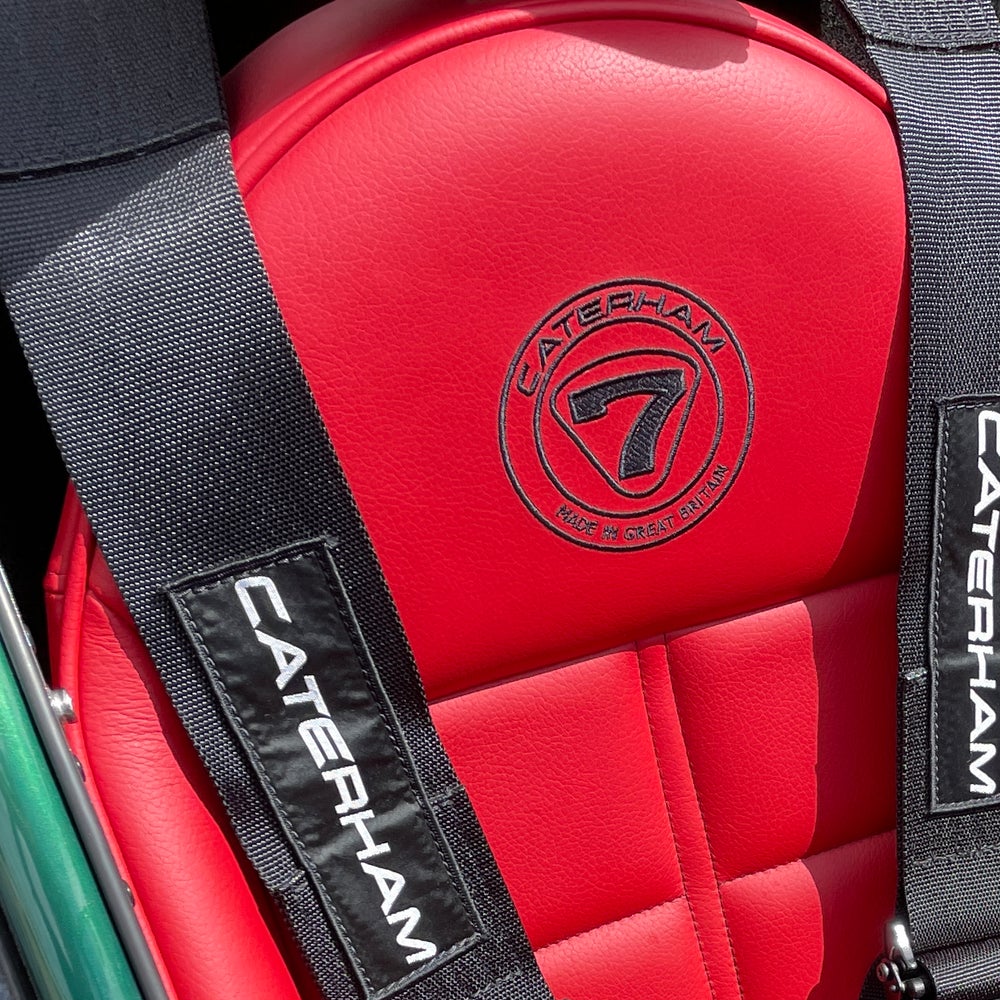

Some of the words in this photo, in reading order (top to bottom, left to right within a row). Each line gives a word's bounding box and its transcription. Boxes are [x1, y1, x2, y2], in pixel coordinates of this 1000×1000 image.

[517, 290, 727, 397] CATERHAM
[567, 368, 687, 480] 7
[555, 503, 599, 536] MADE
[601, 524, 619, 541] IN
[623, 515, 675, 541] GREAT
[679, 464, 729, 519] BRITAIN
[234, 575, 437, 964] CATERHAM
